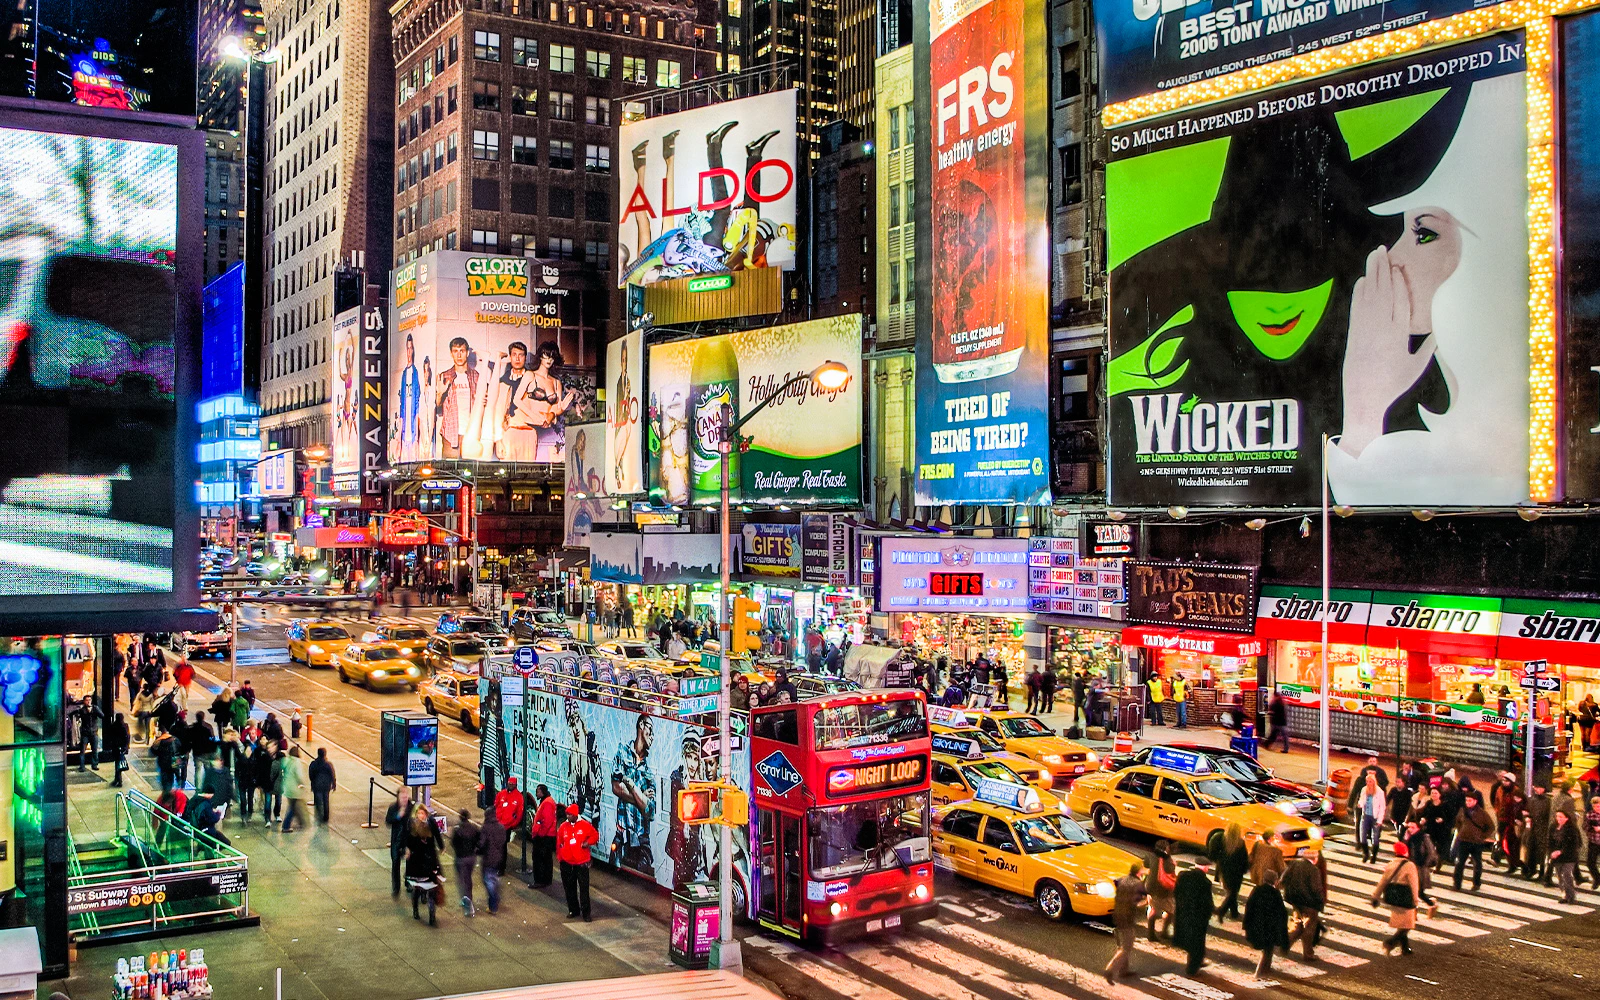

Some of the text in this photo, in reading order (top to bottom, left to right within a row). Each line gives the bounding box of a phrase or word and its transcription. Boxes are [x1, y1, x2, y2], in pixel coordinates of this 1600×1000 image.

[1180, 1, 1253, 40] BEST
[1180, 33, 1218, 59] 2006
[1220, 20, 1263, 47] TONY
[1165, 72, 1204, 88] AUGUST
[1206, 61, 1244, 78] WILSON
[1245, 47, 1294, 68] THEATRE,
[1297, 41, 1319, 54] 245
[1321, 31, 1353, 47] WEST
[1383, 11, 1428, 31] STREET
[938, 52, 1015, 147] FRS
[938, 121, 1017, 171] healthy energy
[620, 159, 793, 223] ALDO
[396, 261, 417, 288] GLORY
[466, 258, 559, 276] GLORY tbs
[468, 275, 529, 297] DAZE
[534, 287, 549, 296] very
[396, 280, 417, 309] DAZE
[481, 301, 556, 315] november 16
[475, 312, 562, 328] tuesdays 10pm
[749, 374, 780, 408] Holly
[364, 311, 383, 494] BRAZZERS
[945, 391, 1010, 423] TIRED OF
[607, 397, 638, 427] ALDO
[930, 422, 1029, 454] BEING TIRED?
[920, 463, 955, 480] FRS.COM
[1156, 467, 1188, 475] GERSHWIN
[1221, 467, 1234, 475] 222
[1235, 466, 1253, 474] WEST
[1267, 465, 1293, 473] STREET
[754, 471, 772, 489] Real
[772, 471, 801, 492] Ginger.
[802, 469, 822, 489] Real
[809, 532, 828, 540] VIDEOS
[1094, 525, 1130, 543] TADS
[752, 536, 793, 557] GIFTS
[1052, 541, 1072, 550] T-SHIRTS
[1029, 555, 1049, 564] T-SHIRTS
[1032, 569, 1046, 579] CAPS
[1052, 570, 1072, 580] T-SHIRTS
[1099, 575, 1121, 584] T-SHIRTS
[1136, 566, 1193, 597] TAD'S
[932, 575, 981, 594] GIFTS
[1030, 585, 1049, 594] T-SHIRTS
[1055, 586, 1069, 595] CAPS
[1075, 587, 1096, 597] T-SHIRTS
[1052, 601, 1072, 611] T-SHIRTS
[1078, 603, 1093, 613] CAPS
[1172, 591, 1246, 620] STEAKS
[1271, 592, 1354, 623] sbarro
[1188, 614, 1210, 622] CHICAGO
[1386, 600, 1481, 632] sbarro
[1142, 635, 1164, 647] TAD'S
[1238, 640, 1261, 655] TAD'S
[1292, 647, 1311, 656] Pizza
[1328, 650, 1359, 664] esserts
[689, 682, 697, 693] W
[698, 679, 710, 692] 47
[679, 696, 717, 711] FATHER DUFFY
[868, 733, 889, 743] 71336
[933, 738, 970, 752] SKYLINE
[855, 765, 887, 786] NIGHT
[890, 760, 920, 782] LOOP
[757, 786, 773, 798] 71336
[984, 857, 1018, 873] NYC TAXI
[74, 883, 167, 902] St Subway Station
[101, 897, 128, 908] & Bklyn
